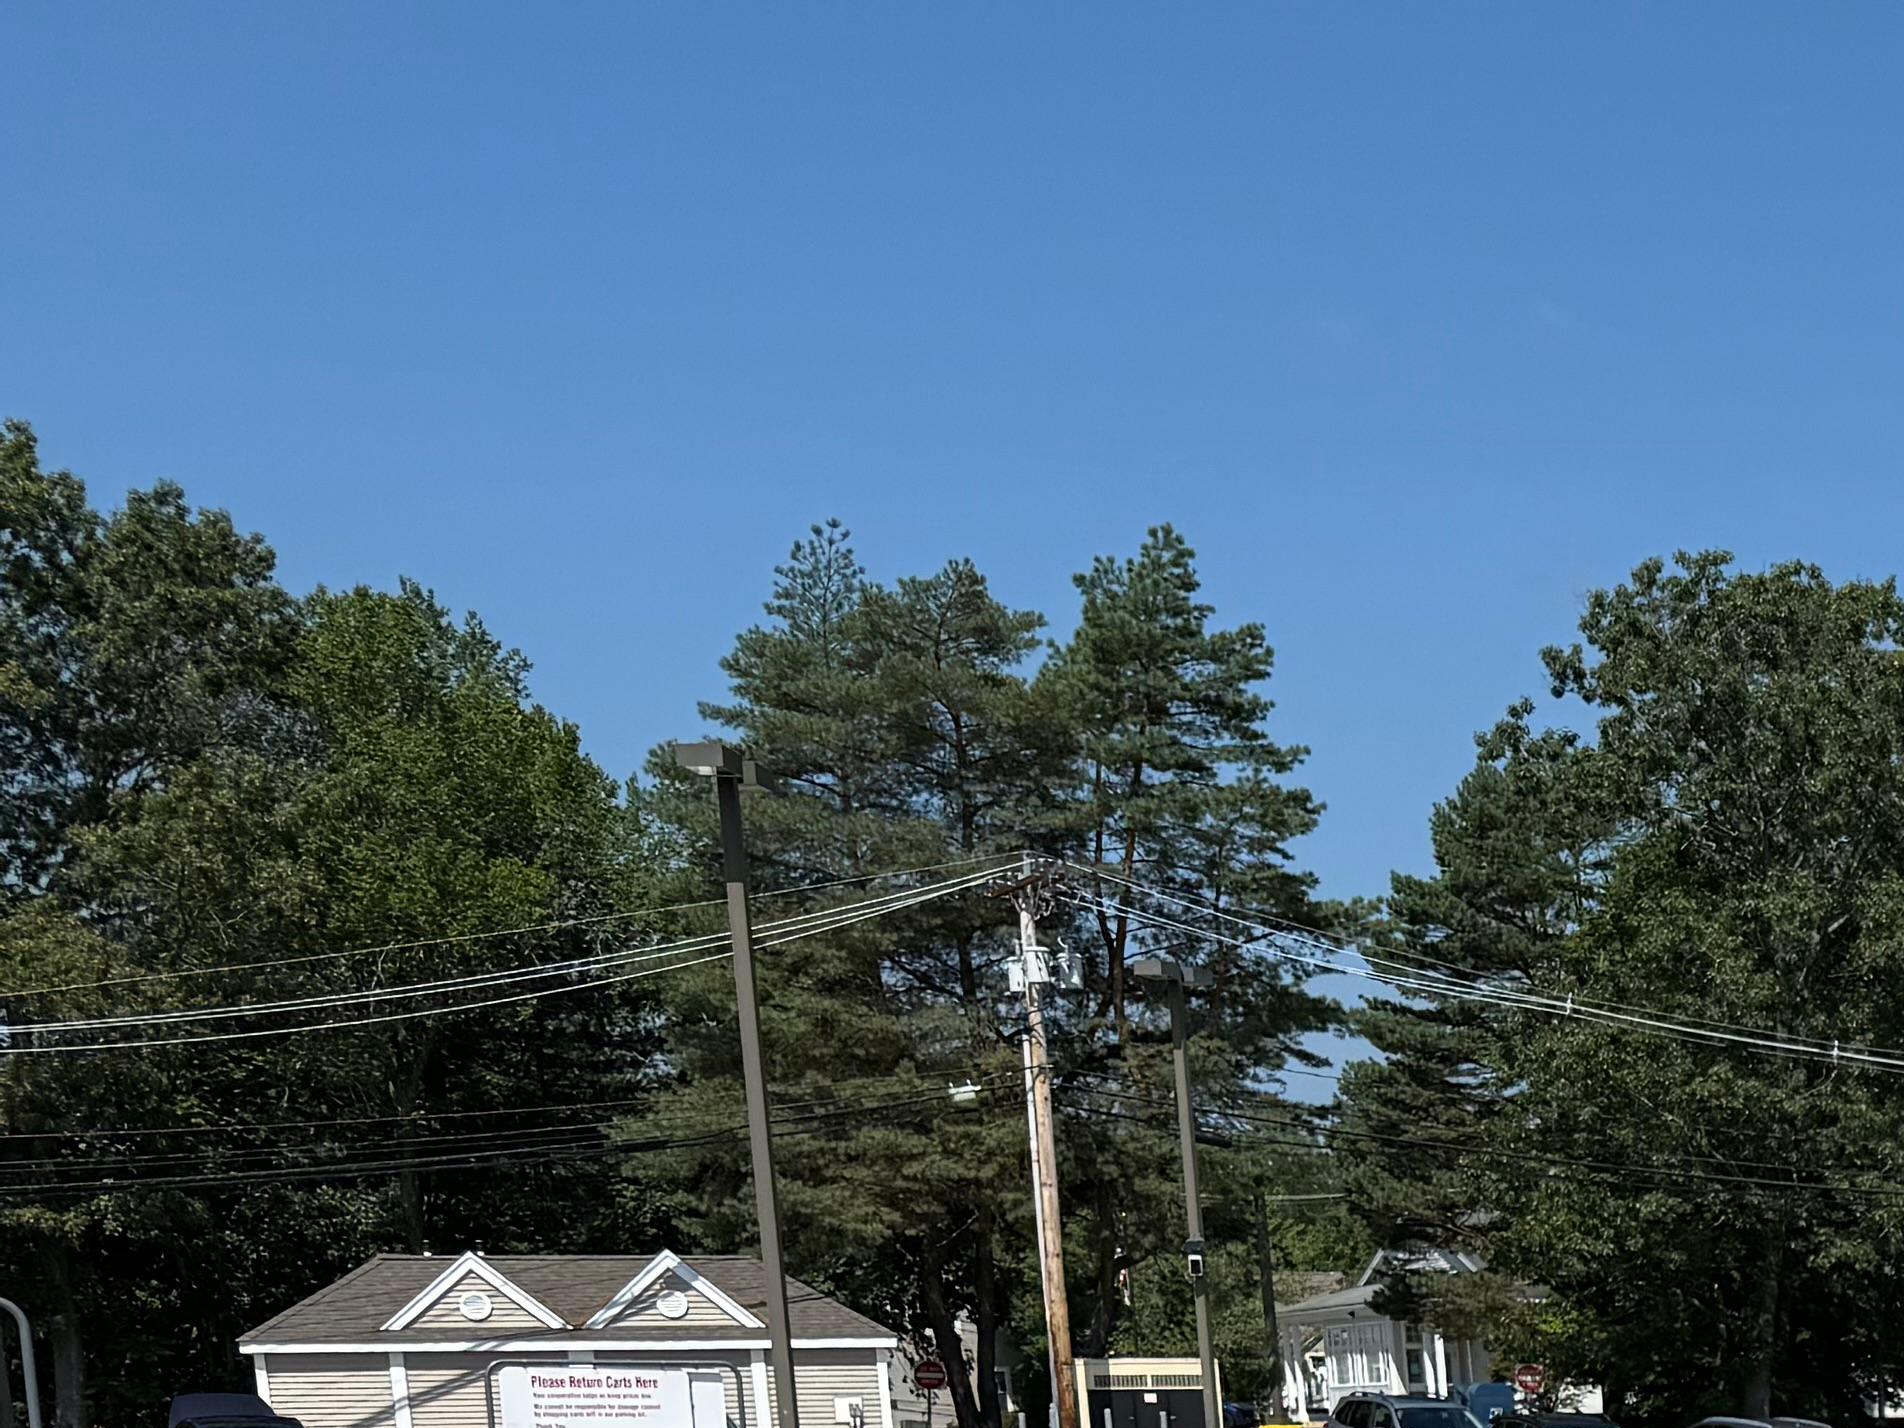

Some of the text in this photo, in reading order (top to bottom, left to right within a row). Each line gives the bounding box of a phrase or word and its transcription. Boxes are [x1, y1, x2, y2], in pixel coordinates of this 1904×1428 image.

[531, 1375, 658, 1388] Please Return Carts Here
